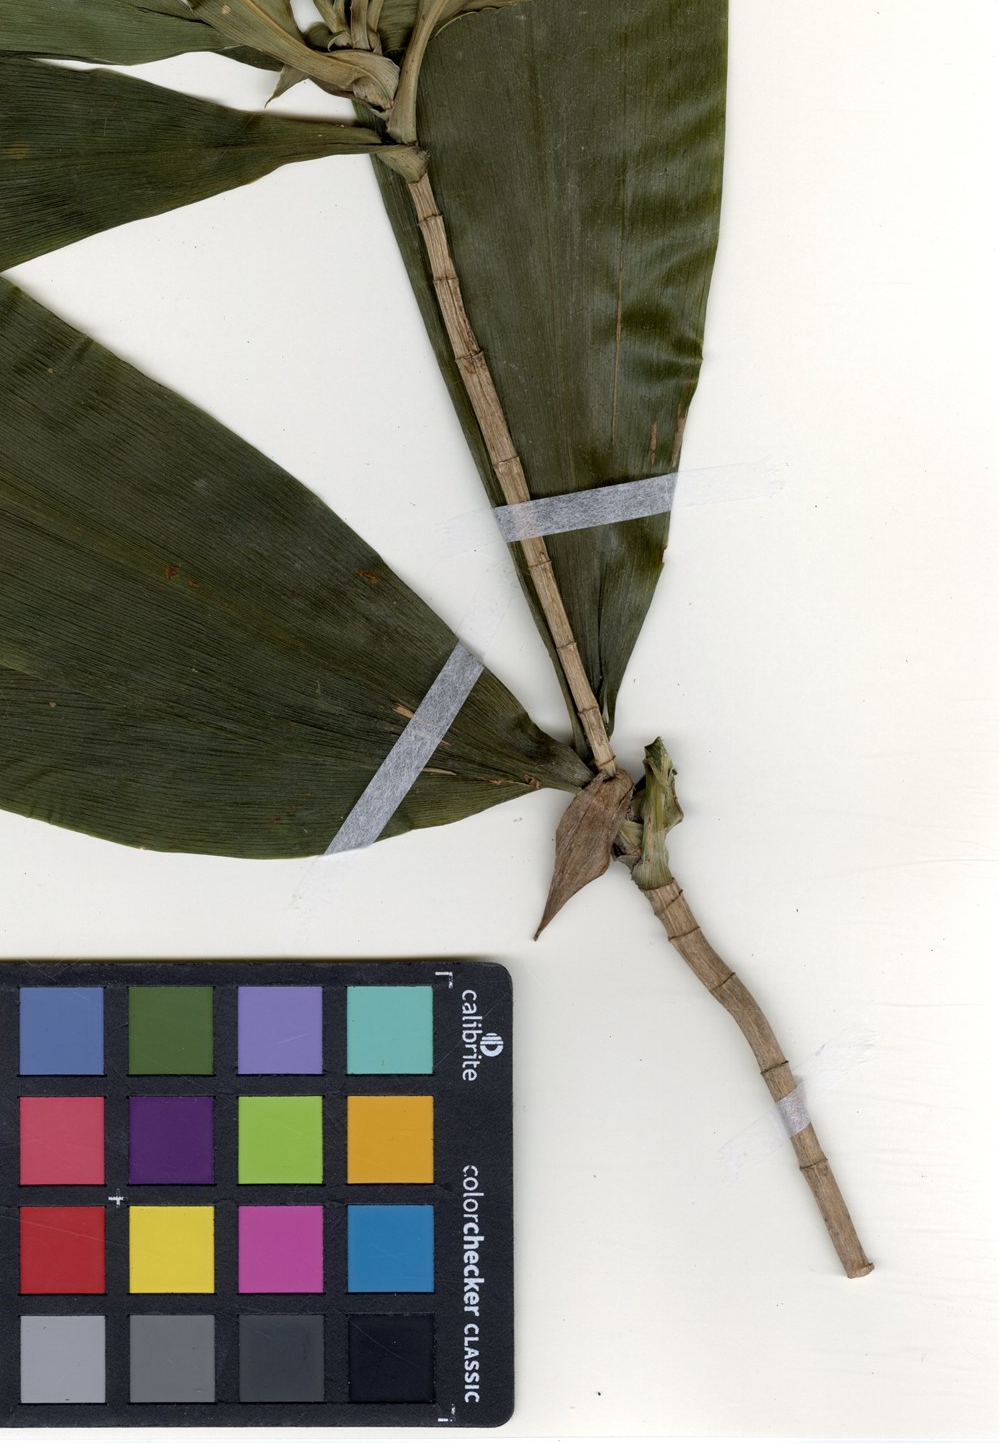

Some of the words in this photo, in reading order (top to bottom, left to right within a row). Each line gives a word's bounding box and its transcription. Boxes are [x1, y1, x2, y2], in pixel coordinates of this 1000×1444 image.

[461, 989, 483, 1082] calibrite
[462, 1164, 485, 1317] colorchecker
[463, 1322, 480, 1404] CLASSIC
